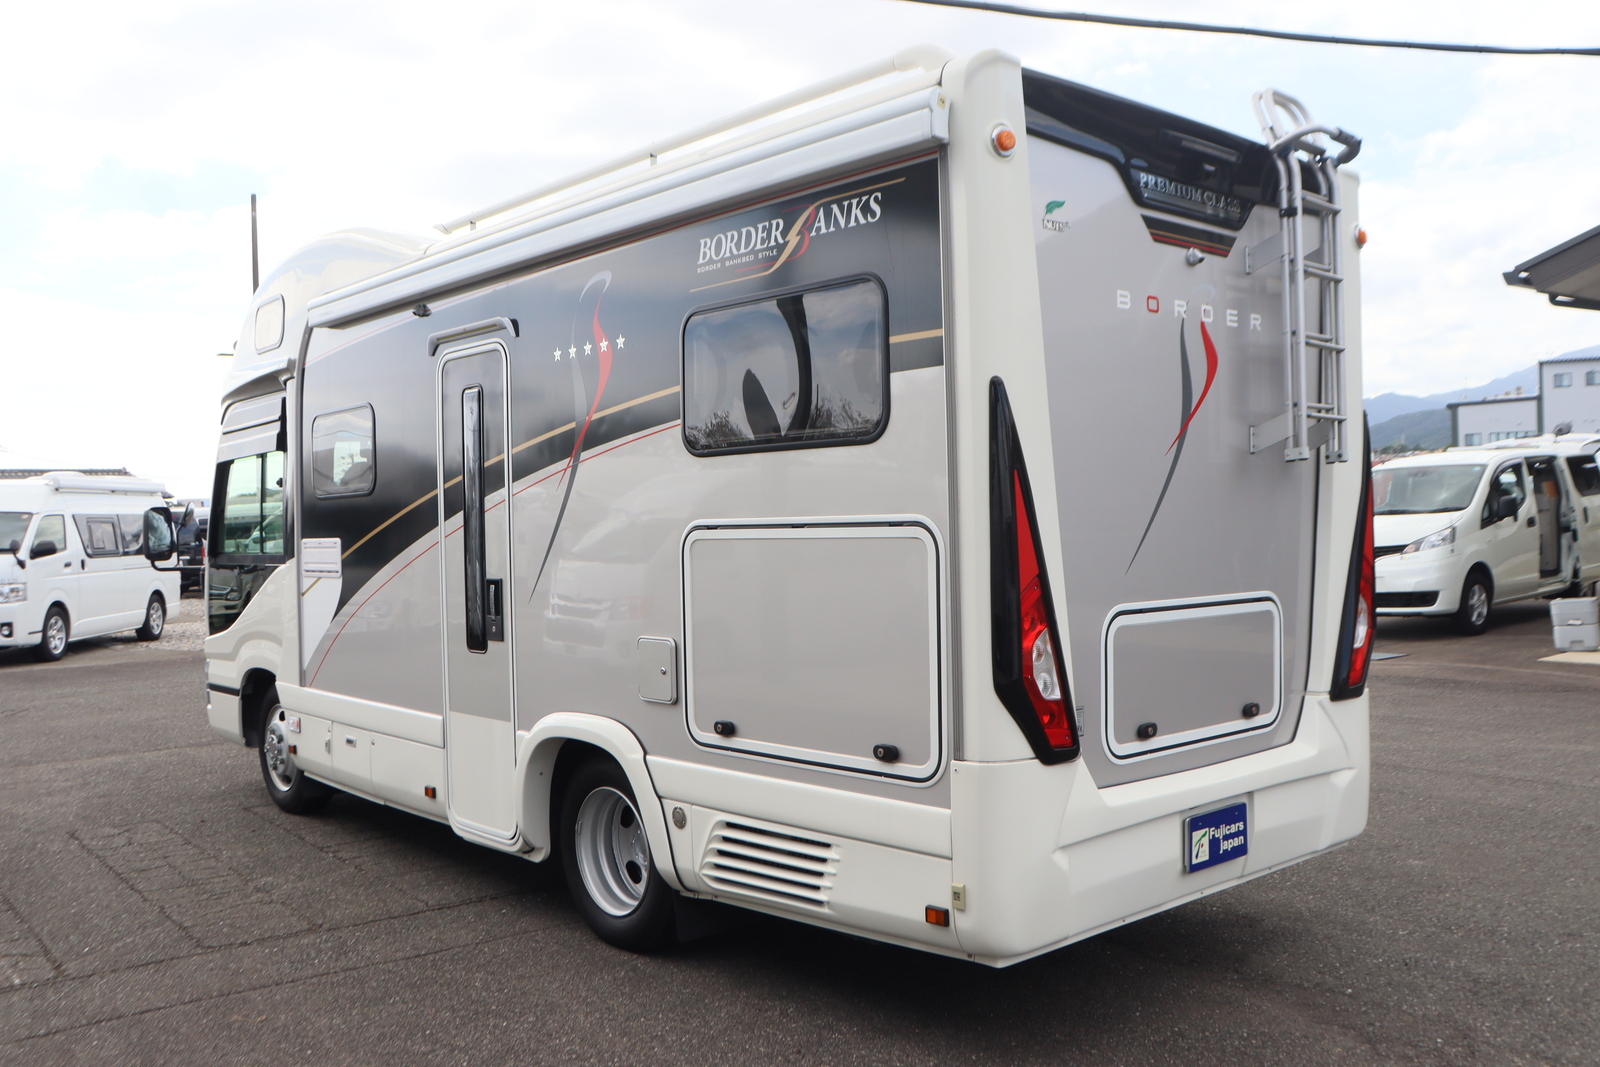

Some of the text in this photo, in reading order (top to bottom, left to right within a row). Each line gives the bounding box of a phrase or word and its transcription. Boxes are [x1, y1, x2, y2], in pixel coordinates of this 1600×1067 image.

[1139, 172, 1202, 202] PREMIUM
[697, 218, 785, 265] BORDER
[697, 263, 721, 274] BORDER
[758, 248, 778, 259] STYLE
[1117, 289, 1262, 332] BORDER
[1209, 821, 1244, 839] Fujicars
